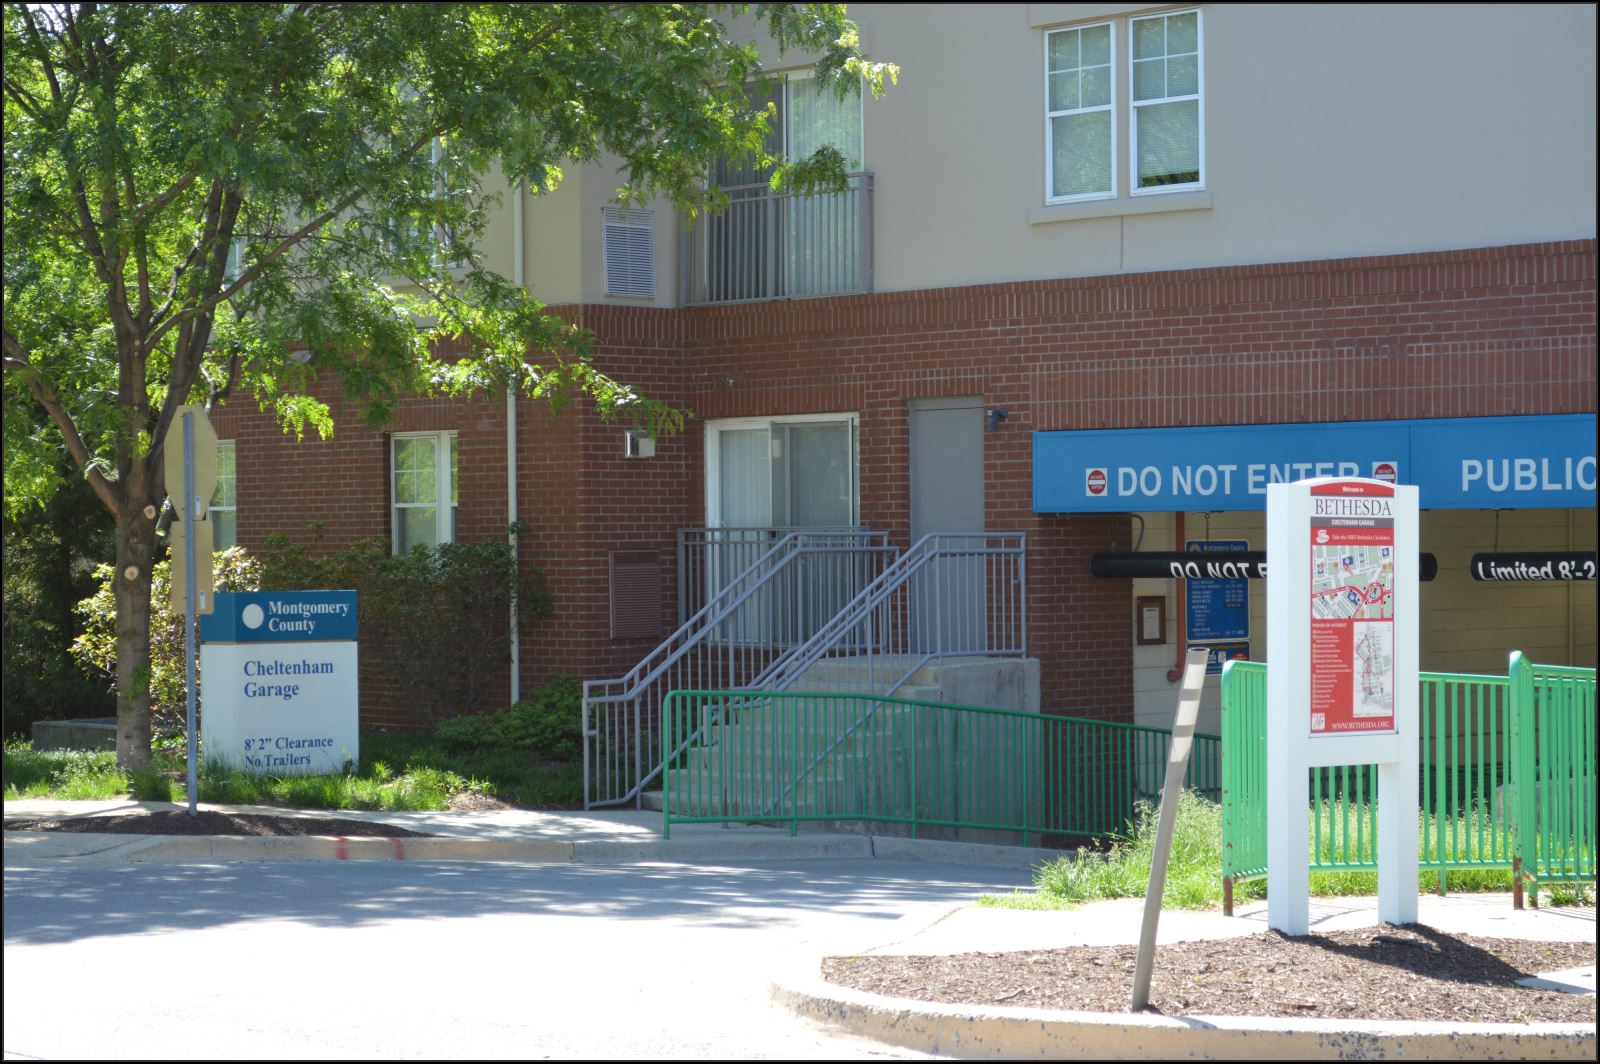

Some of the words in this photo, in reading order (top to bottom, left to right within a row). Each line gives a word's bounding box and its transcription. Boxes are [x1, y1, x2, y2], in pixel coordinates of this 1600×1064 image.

[1118, 466, 1162, 496] DO
[1172, 464, 1238, 496] NOT
[1461, 456, 1597, 492] PUBLIC
[1315, 498, 1392, 516] BETHESDA
[1170, 562, 1201, 578] DO
[1207, 562, 1250, 578] NOT
[1478, 561, 1555, 580] Limited
[268, 601, 349, 617] Montgomery
[268, 617, 316, 634] County
[243, 660, 334, 677] Cheltenham
[243, 682, 300, 700] Garage
[275, 737, 333, 750] Clearance
[245, 755, 261, 768] No
[264, 753, 311, 767] Trailers
